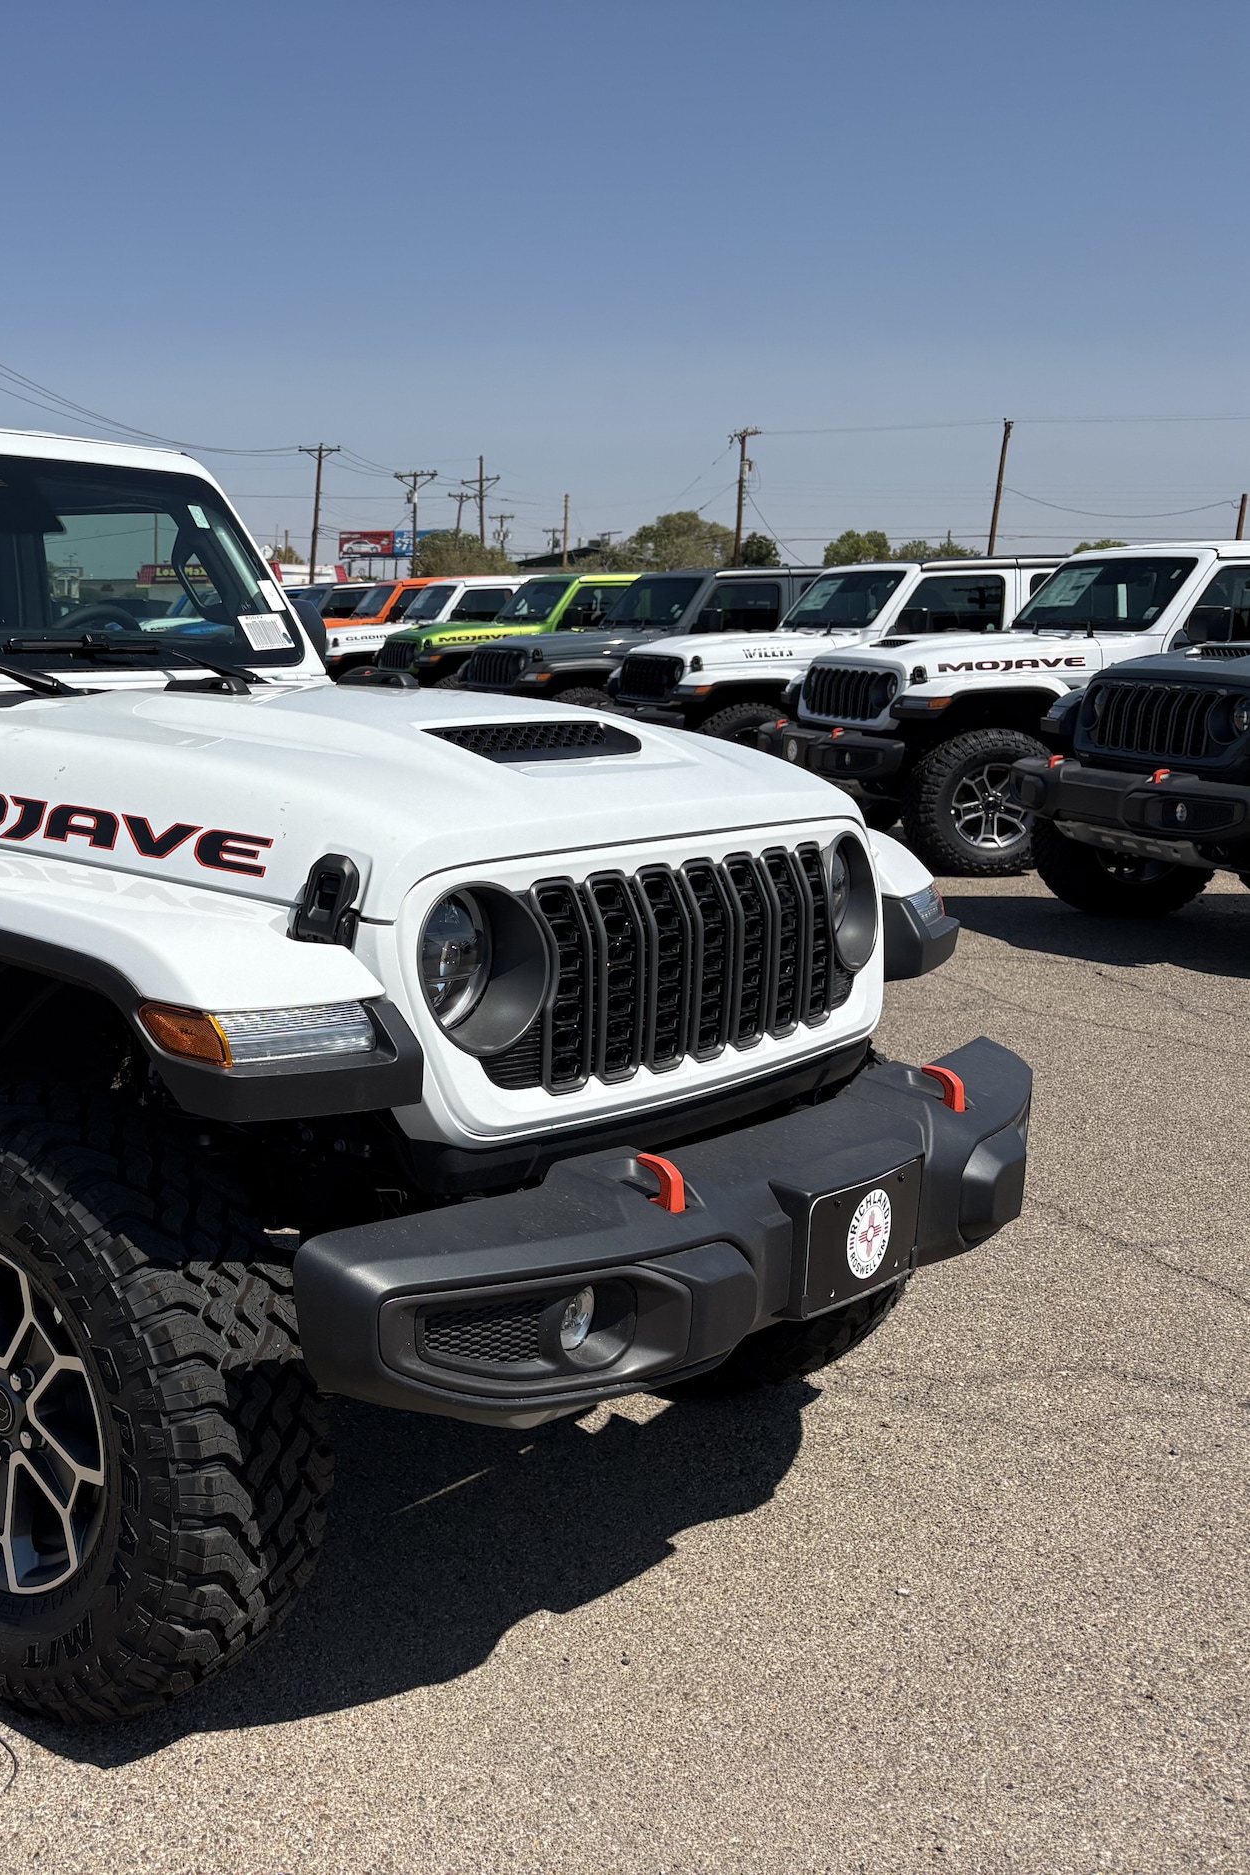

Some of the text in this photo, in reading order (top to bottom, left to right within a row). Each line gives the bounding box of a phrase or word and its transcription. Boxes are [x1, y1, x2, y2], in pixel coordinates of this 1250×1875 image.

[742, 646, 794, 659] WILLYS
[938, 657, 1086, 673] MOJAVE
[850, 1192, 890, 1235] RICHLAND
[850, 1239, 887, 1275] ROSWELL NM
